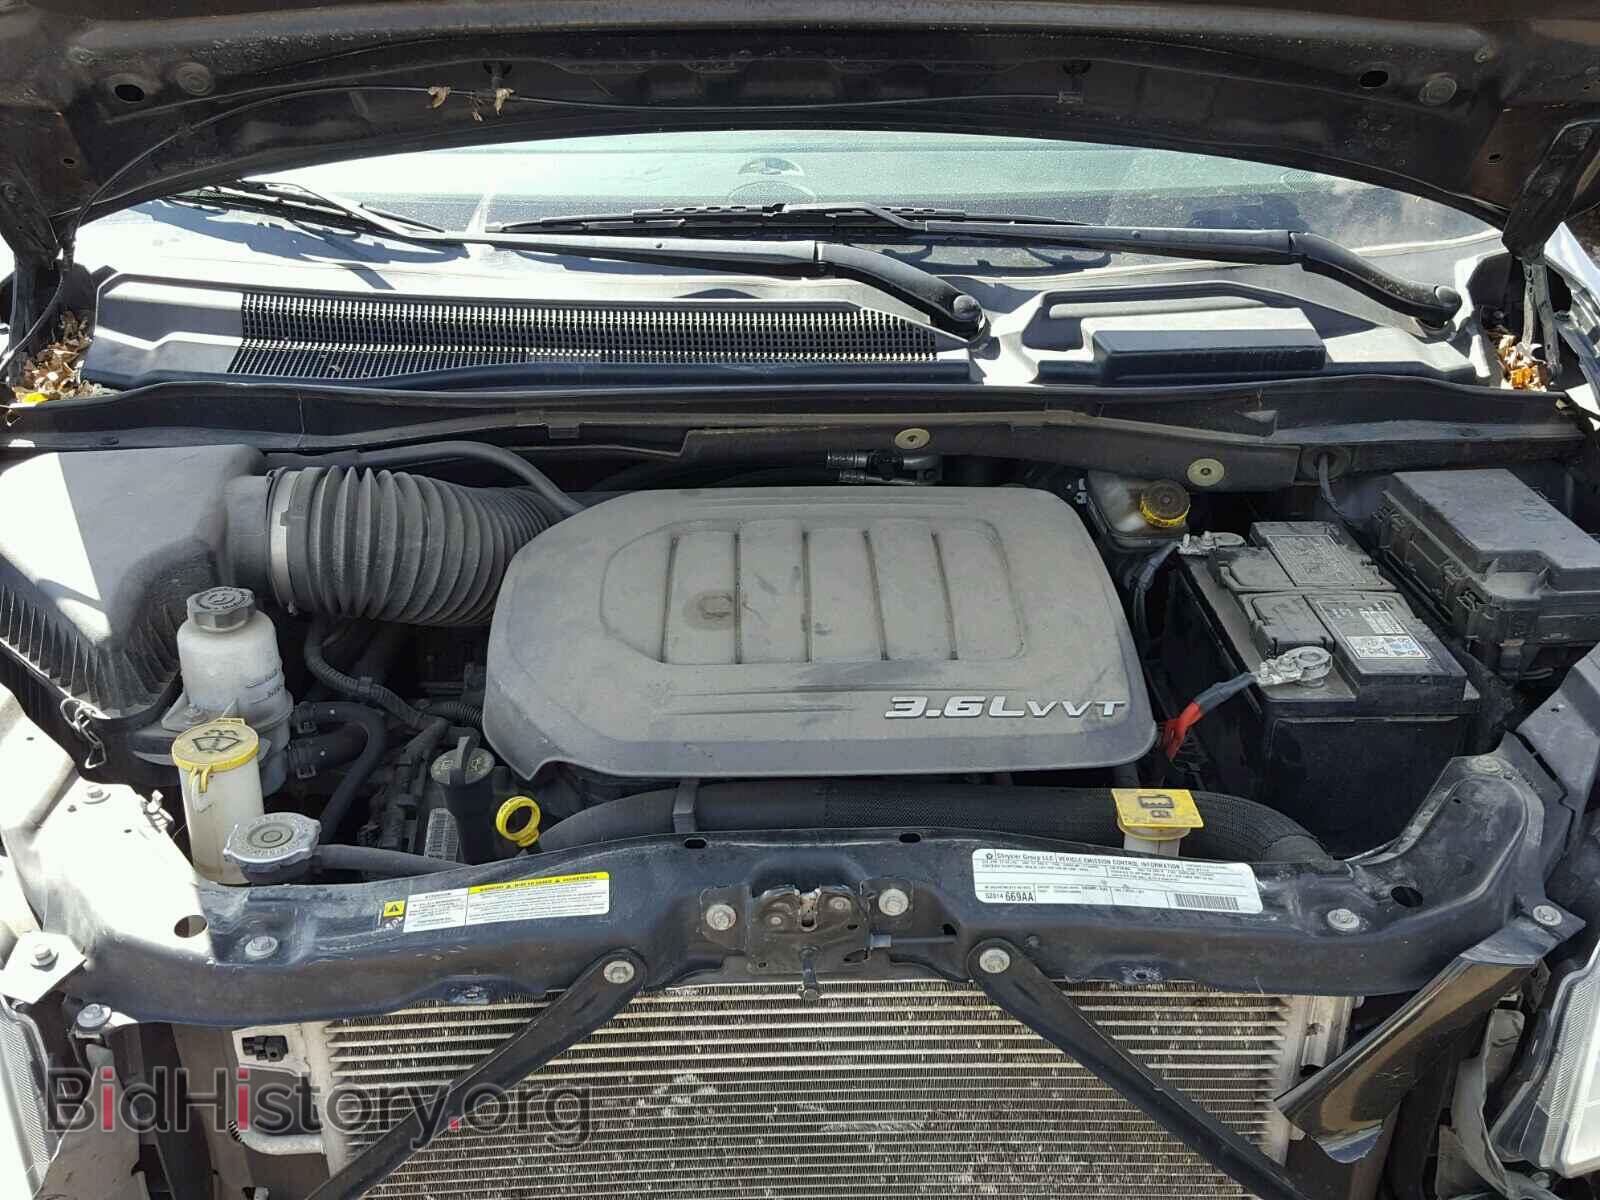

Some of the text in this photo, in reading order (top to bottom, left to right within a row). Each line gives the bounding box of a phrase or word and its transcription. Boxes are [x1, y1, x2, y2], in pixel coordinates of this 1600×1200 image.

[885, 696, 1127, 718] 3.6L VVT
[1084, 857, 1111, 865] EMISSION
[1112, 859, 1138, 868] CONTROL
[1140, 861, 1181, 870] INFORMATION
[1005, 891, 1034, 902] 669AA
